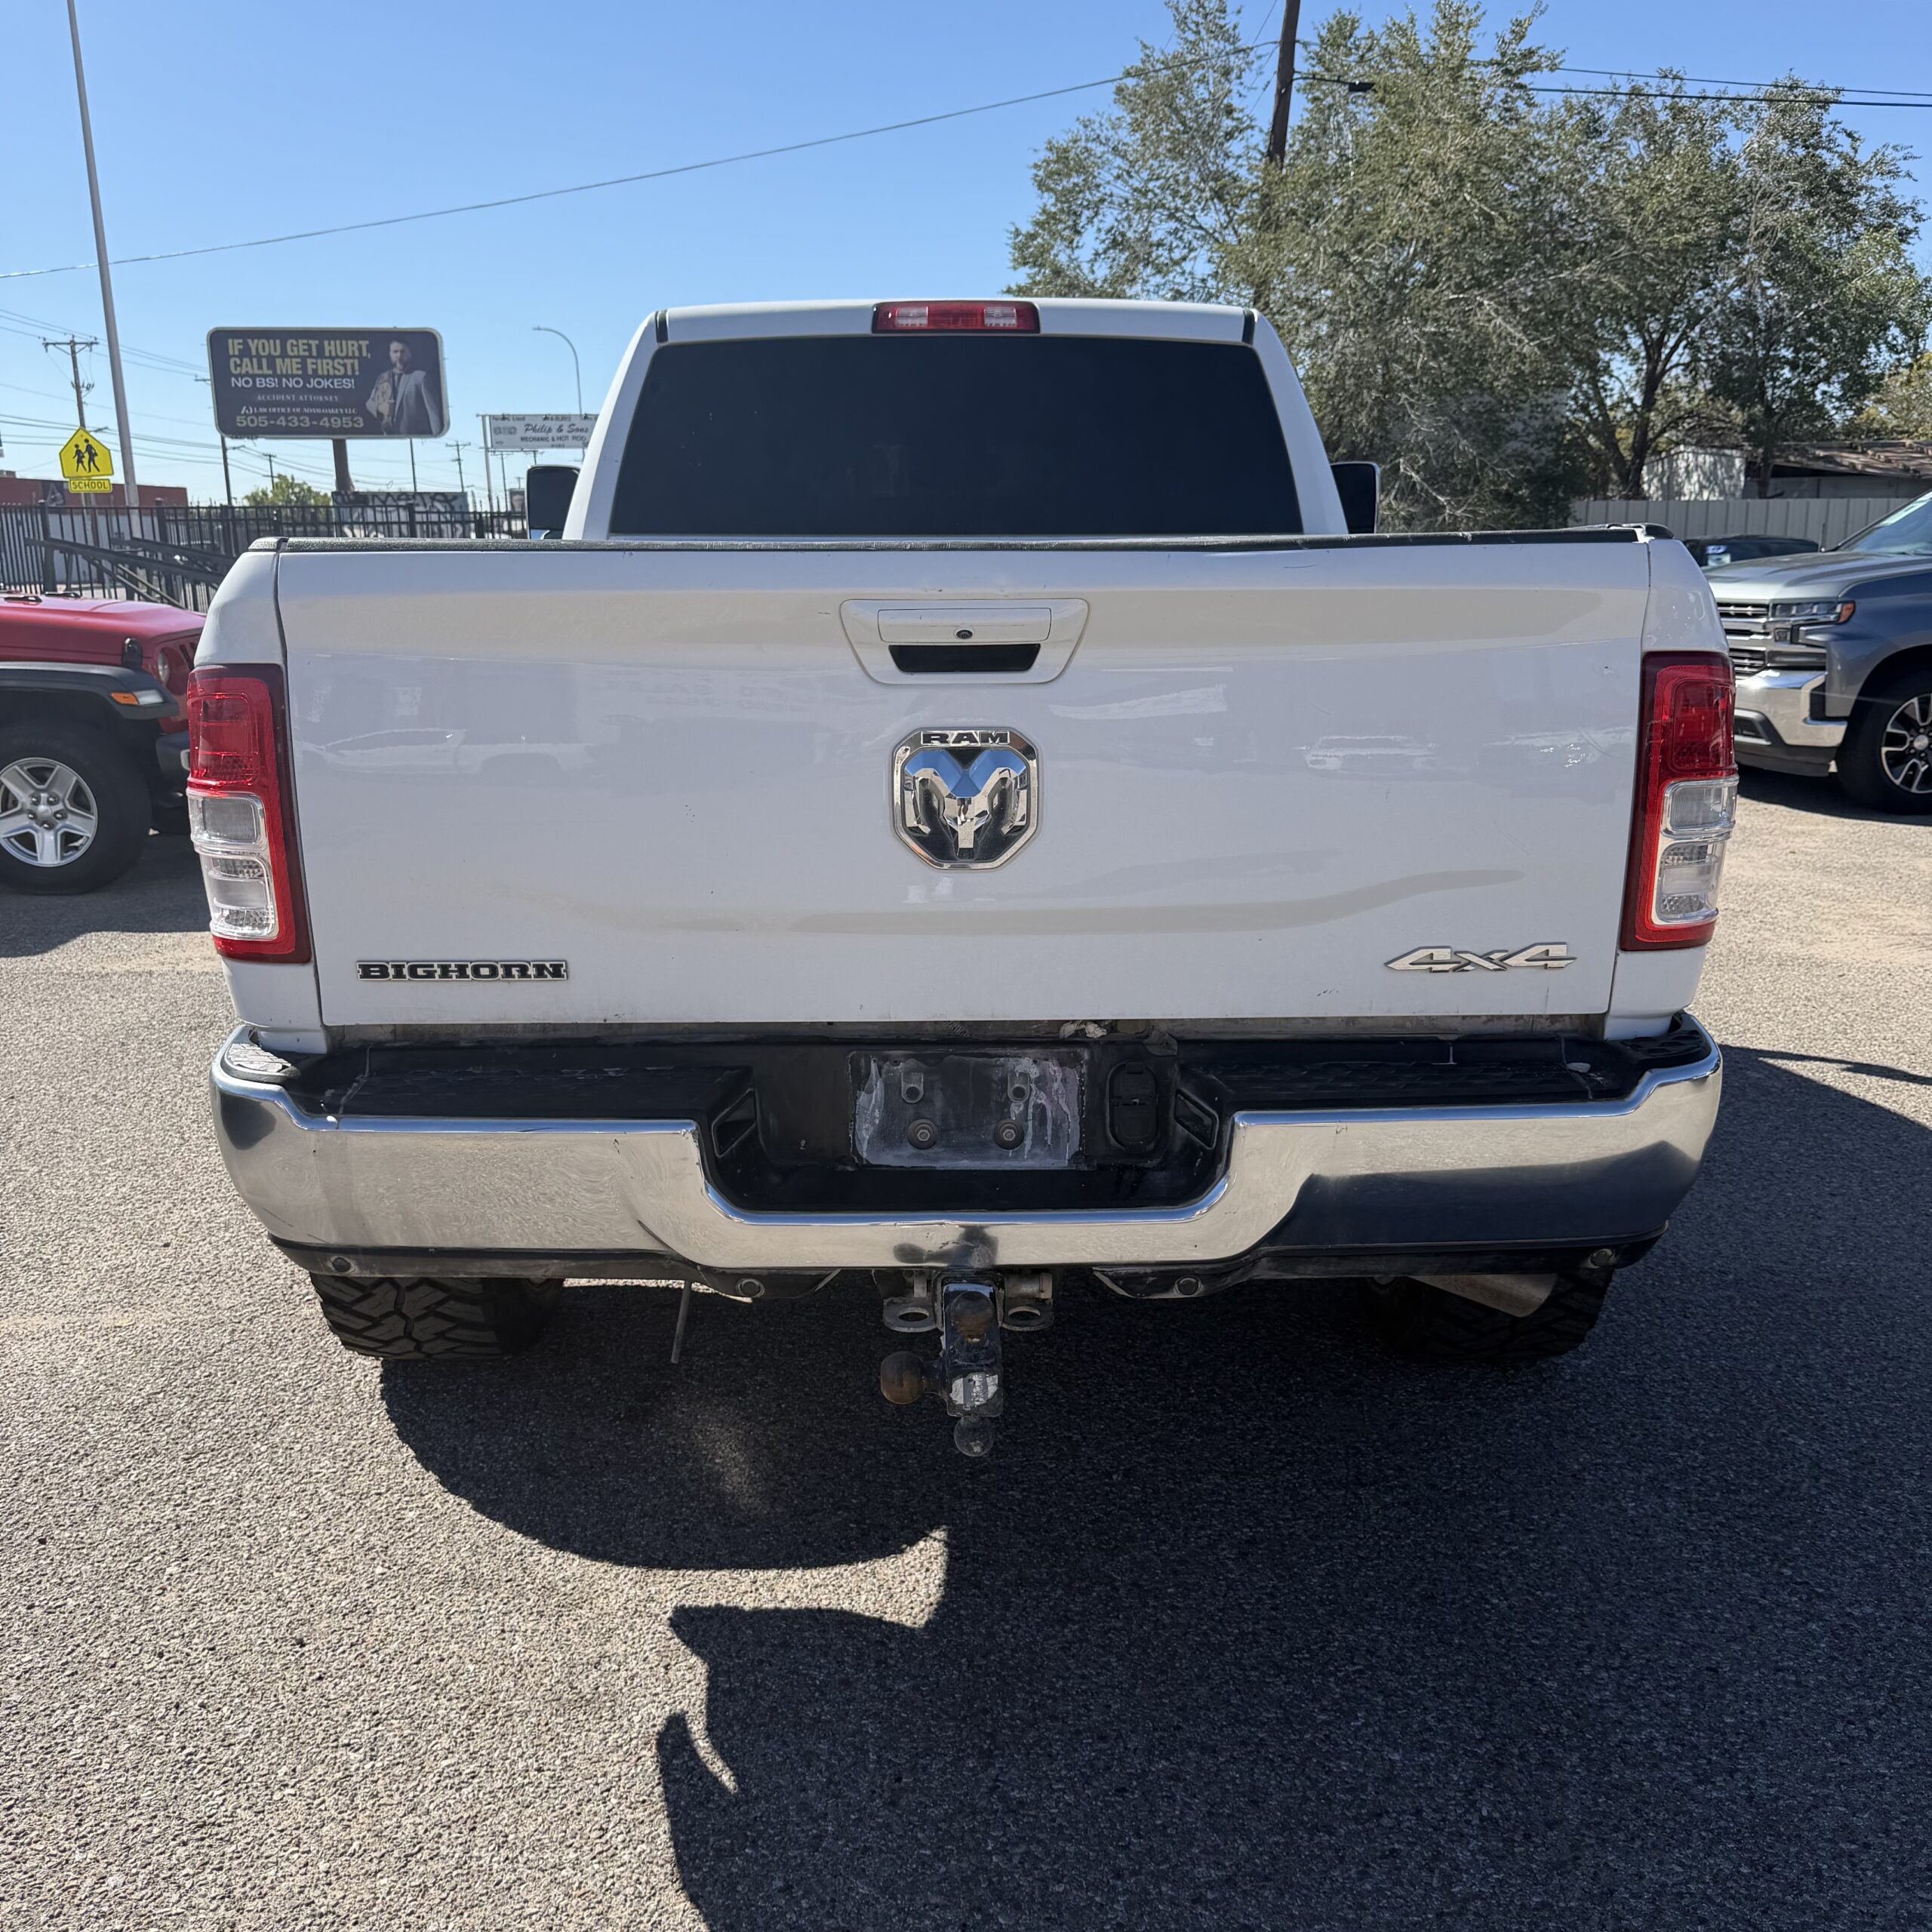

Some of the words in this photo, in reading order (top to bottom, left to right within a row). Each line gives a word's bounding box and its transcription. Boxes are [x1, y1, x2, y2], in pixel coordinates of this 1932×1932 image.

[228, 339, 243, 355] IF
[247, 339, 281, 356] YOU
[287, 339, 318, 356] GET
[324, 340, 371, 358] HURT,
[229, 357, 272, 374] CALL
[275, 358, 302, 374] ME
[306, 358, 359, 376] FIRST!
[231, 377, 253, 388] NO
[256, 377, 278, 388] BS!
[282, 377, 303, 388] NO
[306, 378, 355, 389] JOKES!
[236, 416, 364, 428] 505-433-4953
[525, 423, 552, 434] Philip
[567, 423, 589, 433] Sons
[72, 481, 109, 490] SCHOOL
[921, 731, 1010, 746] RAM
[356, 960, 568, 981] BIGHORN
